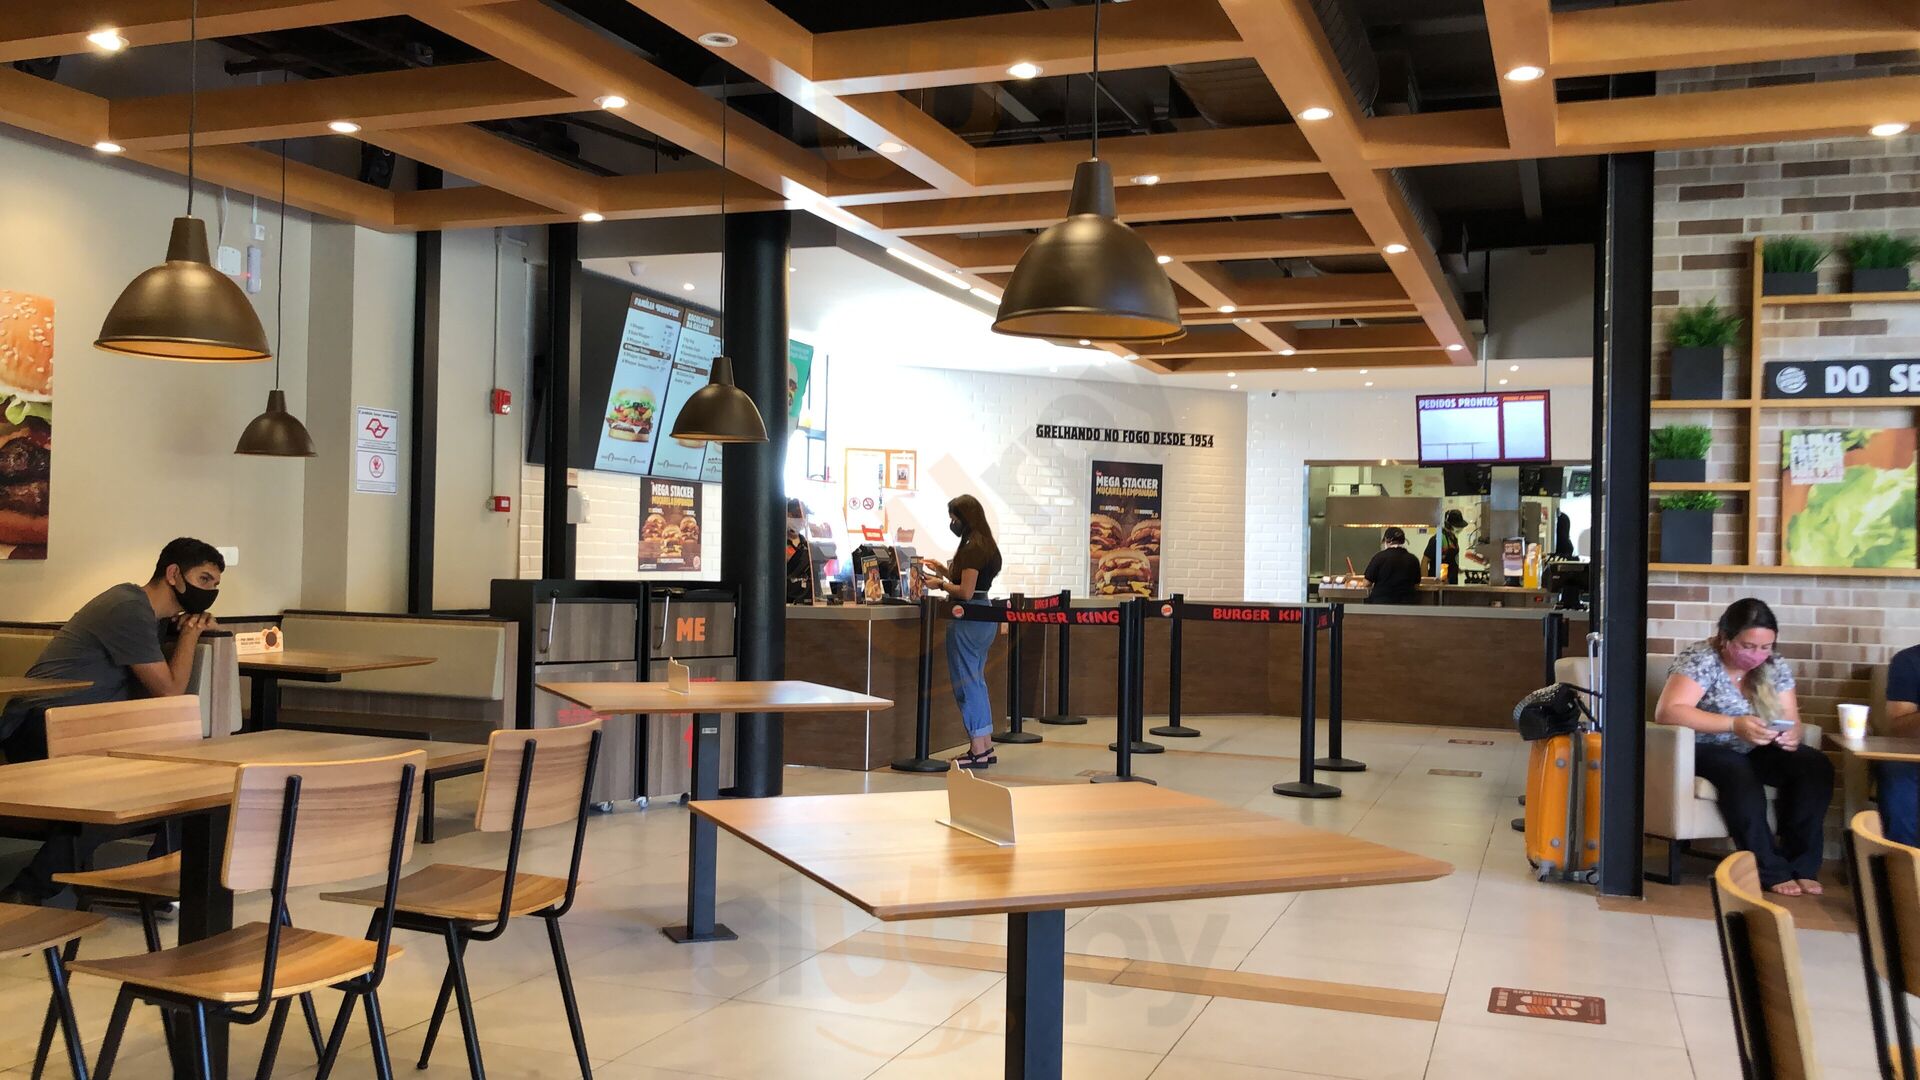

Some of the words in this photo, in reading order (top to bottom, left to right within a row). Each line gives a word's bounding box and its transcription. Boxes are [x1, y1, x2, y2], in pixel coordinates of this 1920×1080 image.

[1825, 365, 1869, 394] DO
[1419, 398, 1456, 410] PEDIDOS
[1458, 396, 1499, 408] PRONTOS
[1036, 424, 1101, 440] GRELHANDO
[1104, 428, 1119, 442] NO
[1122, 429, 1150, 444] FOGO
[1153, 432, 1186, 446] DESDE
[1189, 434, 1214, 448] 1954
[1096, 476, 1121, 487] MEGA
[1122, 477, 1159, 489] STACKER
[652, 484, 670, 496] MEGA
[670, 485, 694, 498] STACKER
[1006, 611, 1068, 624] BURGER
[1077, 610, 1120, 624] KING
[1213, 608, 1270, 622] BURGER
[1278, 609, 1302, 622] KIN
[676, 617, 706, 642] ME
